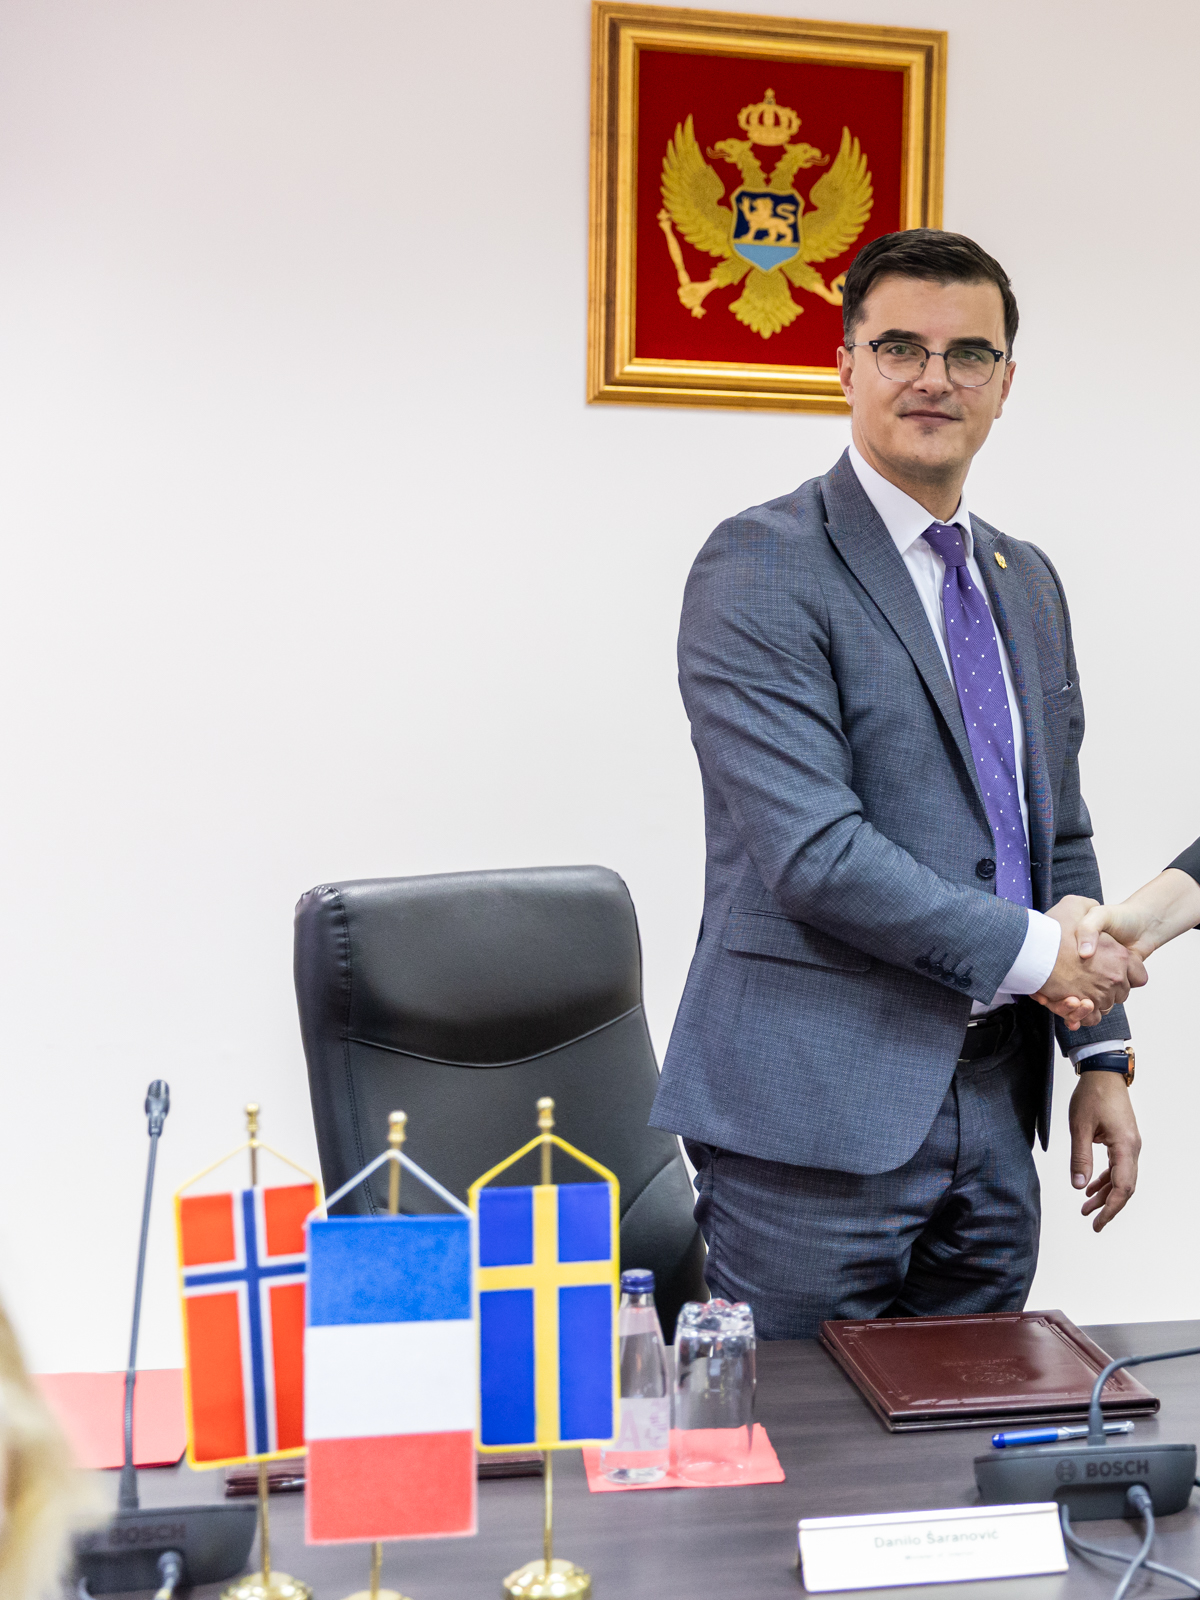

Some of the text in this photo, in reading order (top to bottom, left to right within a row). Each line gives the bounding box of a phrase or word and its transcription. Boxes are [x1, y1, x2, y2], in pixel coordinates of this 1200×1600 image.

[1086, 1460, 1150, 1477] BOSCH
[108, 1523, 187, 1546] BOSCH
[874, 1529, 999, 1548] Danilo Šaranović
